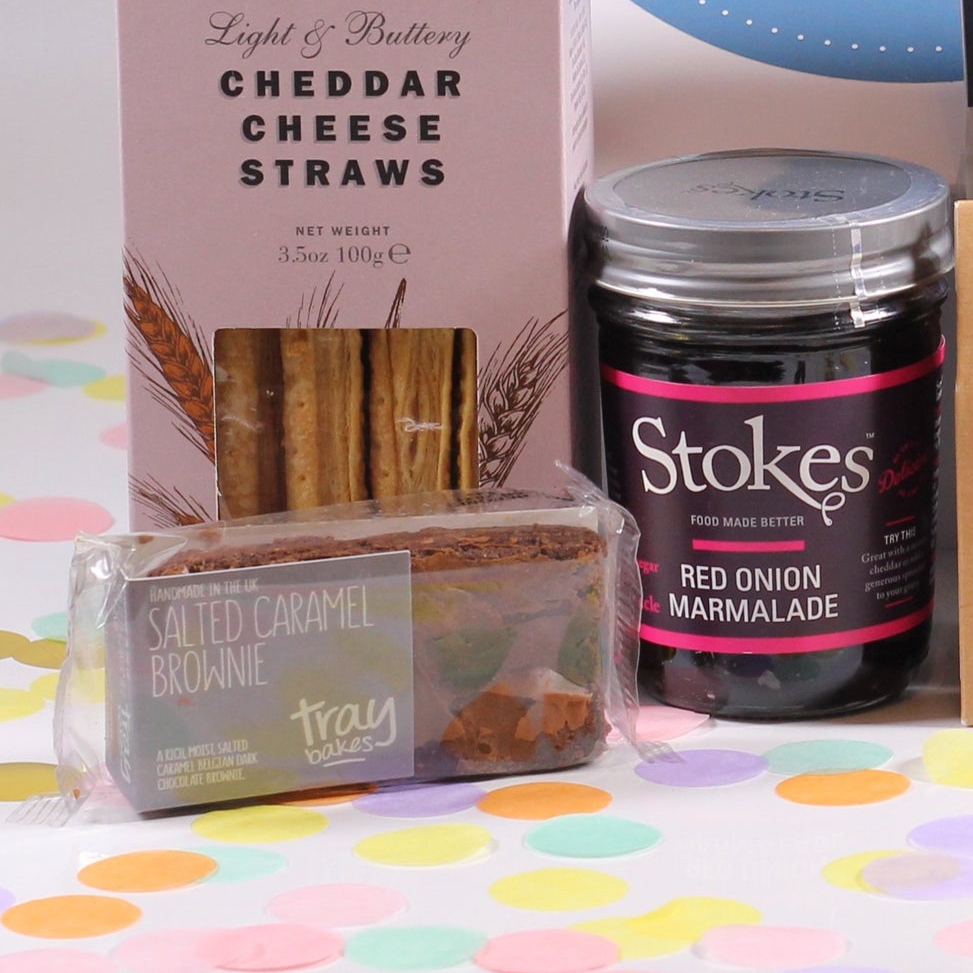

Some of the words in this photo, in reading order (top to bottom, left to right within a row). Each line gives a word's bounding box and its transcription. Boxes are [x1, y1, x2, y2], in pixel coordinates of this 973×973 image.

[204, 11, 297, 59] Light
[300, 19, 336, 59] &
[344, 10, 471, 59] Buttery
[219, 70, 461, 98] CHEDDAR
[241, 114, 441, 142] CHEESE
[240, 158, 445, 187] STRAWS
[295, 226, 324, 237] NET
[331, 226, 390, 237] WEIGHT
[278, 245, 328, 264] 3.5oz
[632, 414, 874, 526] Stokes
[690, 514, 719, 527] FOOD
[723, 515, 758, 528] MADE
[760, 515, 805, 527] BETTER
[884, 532, 899, 545] TRY
[861, 548, 886, 565] Great
[870, 559, 901, 576] cheddar
[150, 582, 205, 603] HANDMADE
[209, 581, 221, 597] IN
[224, 580, 241, 595] THE
[244, 578, 259, 594] UK
[680, 563, 727, 591] RED
[735, 564, 821, 592] ONION
[865, 576, 901, 593] generous
[877, 589, 885, 600] to
[149, 599, 242, 651] SALTED
[254, 585, 375, 639] CARAMEL
[668, 593, 839, 623] MARMALADE
[151, 642, 268, 698] BROWNIE
[290, 697, 397, 746] tray
[217, 739, 248, 754] SALTED
[304, 735, 373, 765] bakes
[157, 761, 195, 776] CARAMEL
